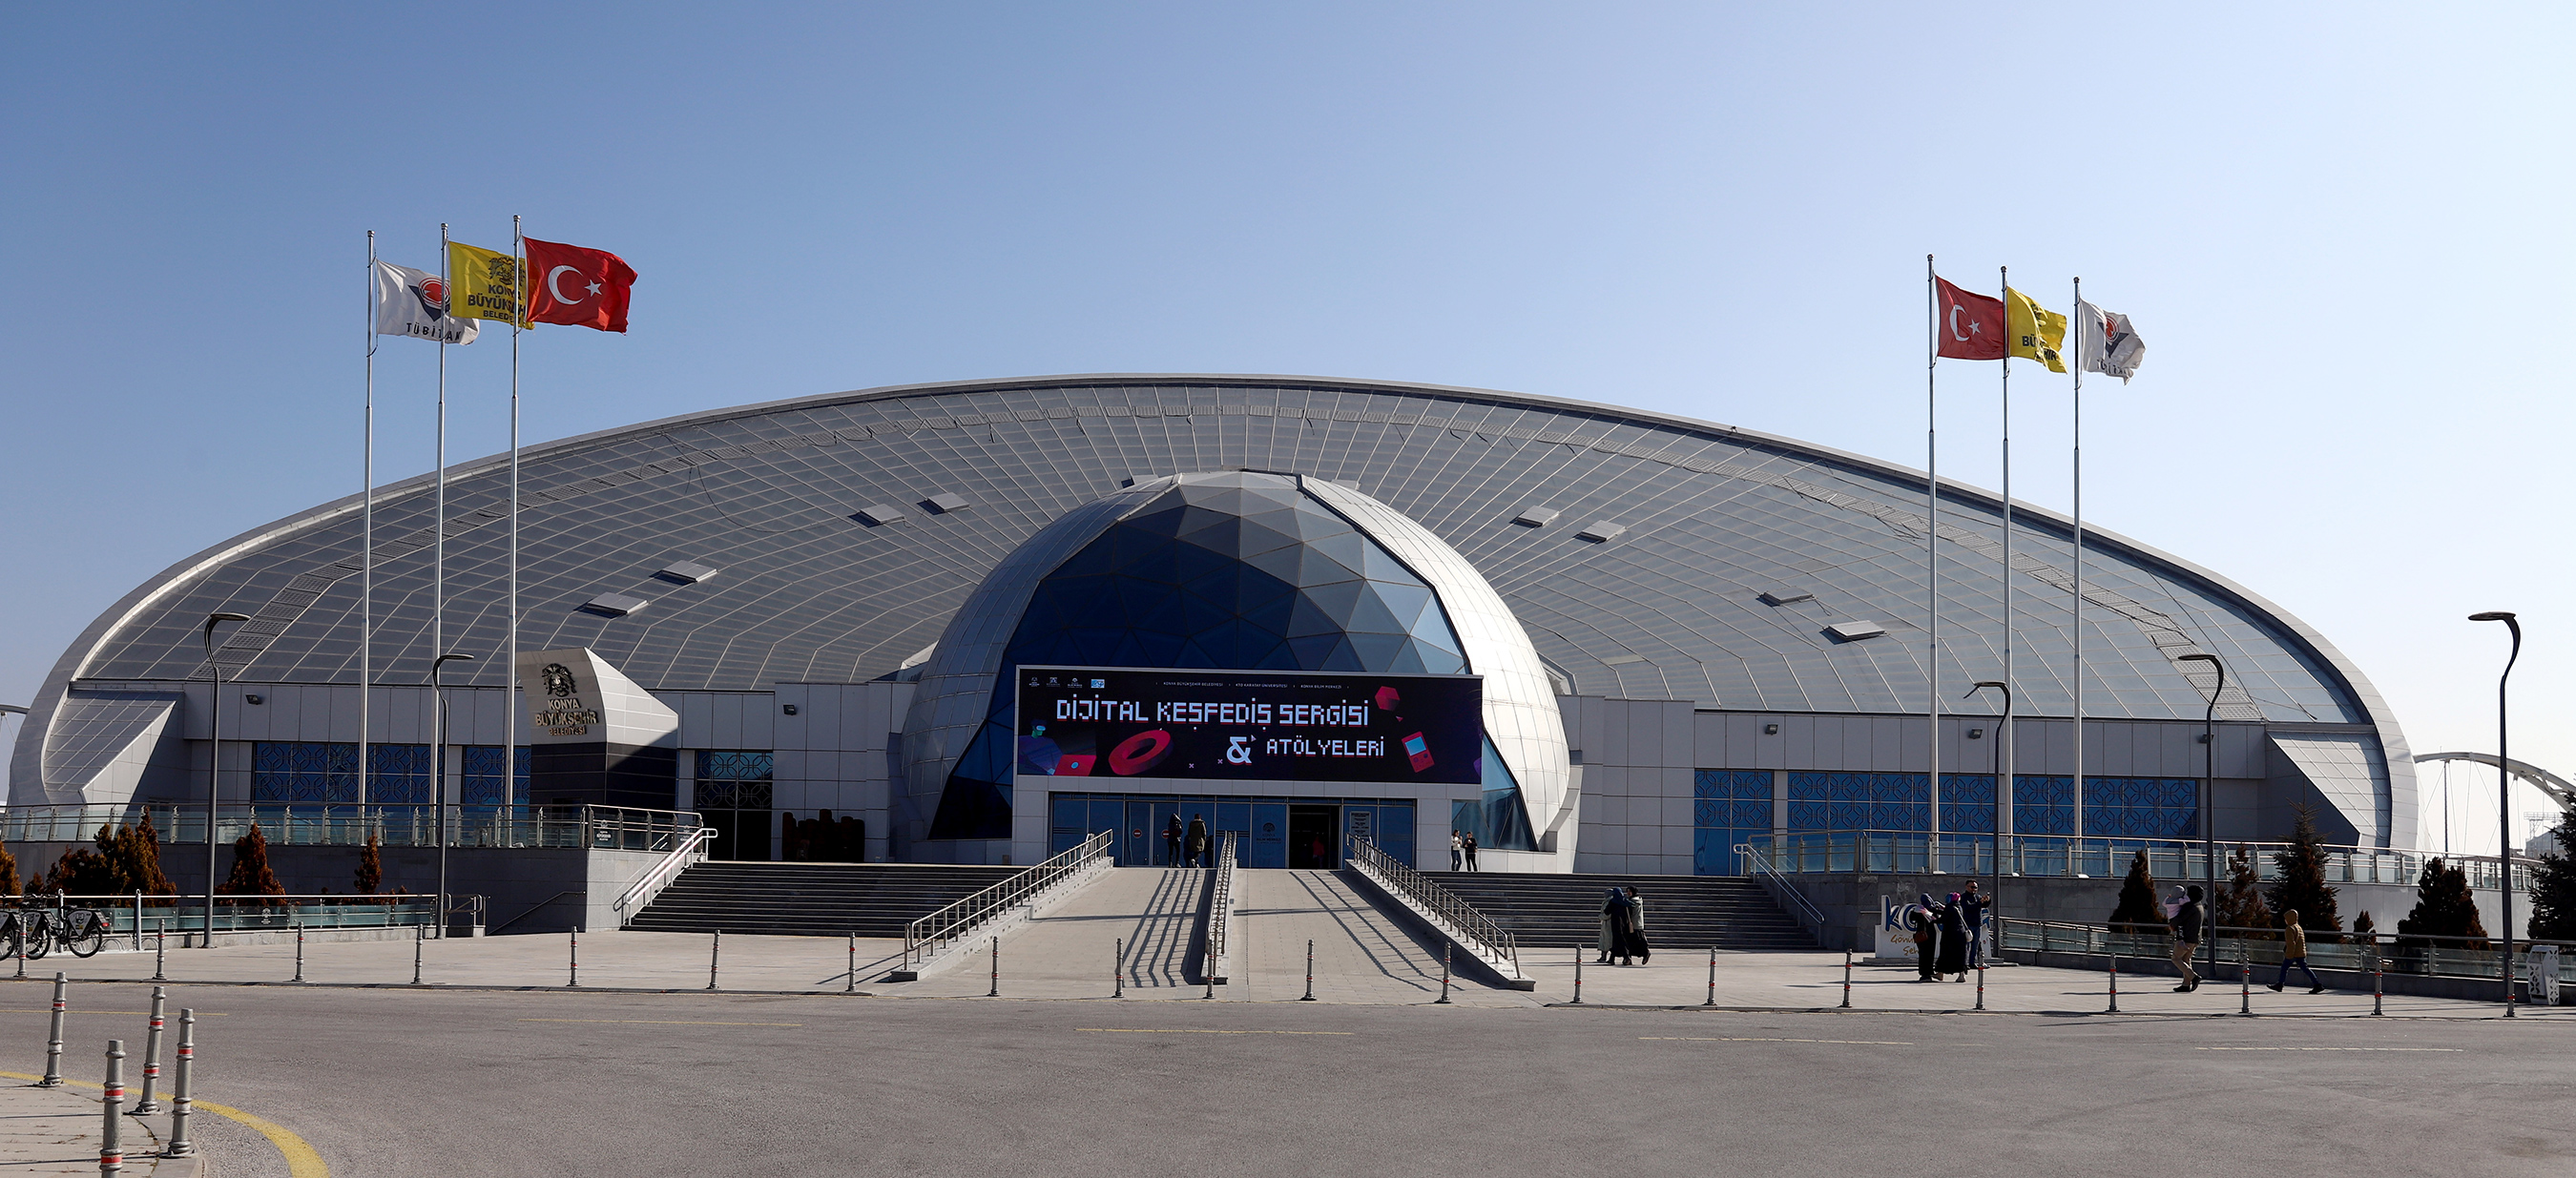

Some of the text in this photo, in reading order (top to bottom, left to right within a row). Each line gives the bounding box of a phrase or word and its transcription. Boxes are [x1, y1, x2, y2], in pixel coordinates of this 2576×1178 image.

[548, 698, 580, 711] KONYA
[1056, 693, 1369, 732] DİJİTAL KEŞFEDİŞ SERGİSİ
[535, 709, 598, 726] BÜYÜKŞEHİR
[549, 725, 587, 735] BELEDİYESİ
[1226, 736, 1252, 765] &
[1266, 734, 1384, 758] ATÖLYELERİ
